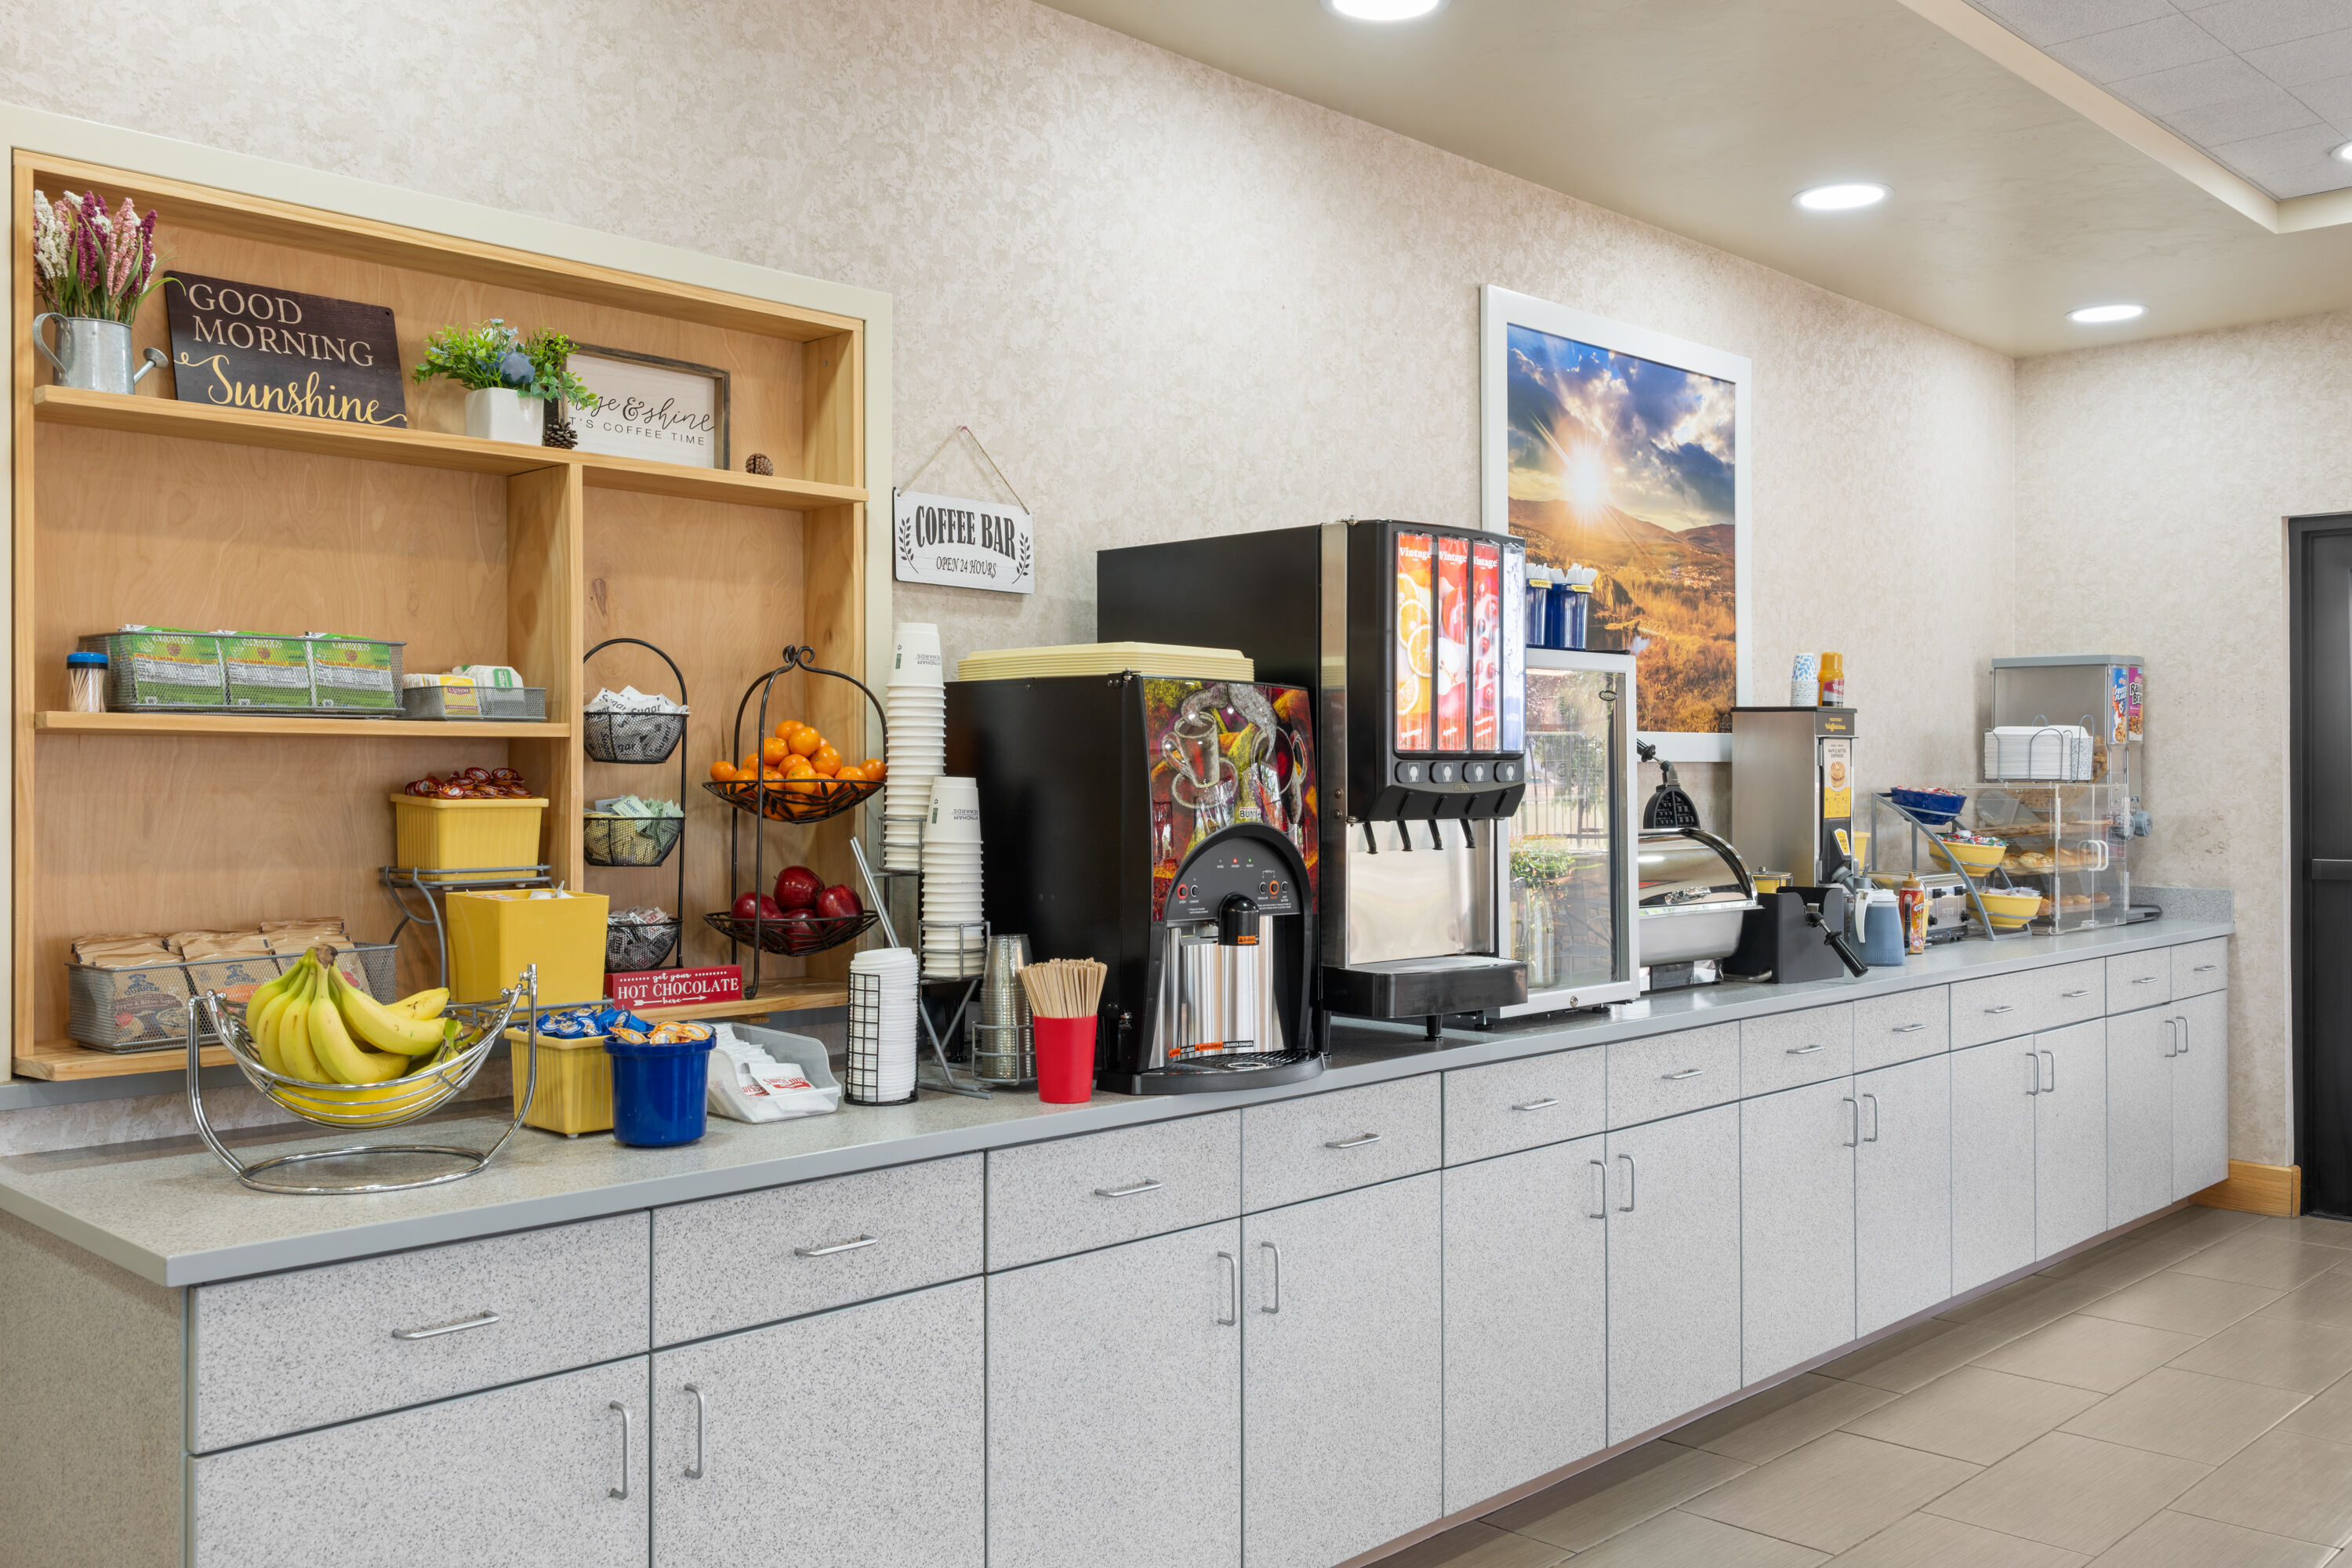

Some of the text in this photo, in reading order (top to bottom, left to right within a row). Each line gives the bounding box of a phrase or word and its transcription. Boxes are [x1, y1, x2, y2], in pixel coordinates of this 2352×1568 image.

[188, 284, 303, 325] GOOD
[192, 315, 375, 366] MORNING
[174, 352, 408, 425] Sunshine
[568, 416, 705, 446] T'S COFFEE TIME
[915, 506, 1016, 561] COFFEE BAR
[1399, 547, 1432, 561] Vintage
[1439, 551, 1468, 564] Vintage
[936, 556, 997, 579] OPEN 24 HOURS
[2130, 682, 2143, 695] Rais
[2132, 694, 2143, 705] Bra
[631, 704, 661, 717] Sugar
[1401, 728, 1423, 739] Orange
[1442, 726, 1458, 737] Apple
[623, 800, 641, 815] Sweet
[652, 972, 691, 983] get your
[125, 986, 160, 996] QUAKER
[618, 978, 739, 1000] HOT CHOCOLATE
